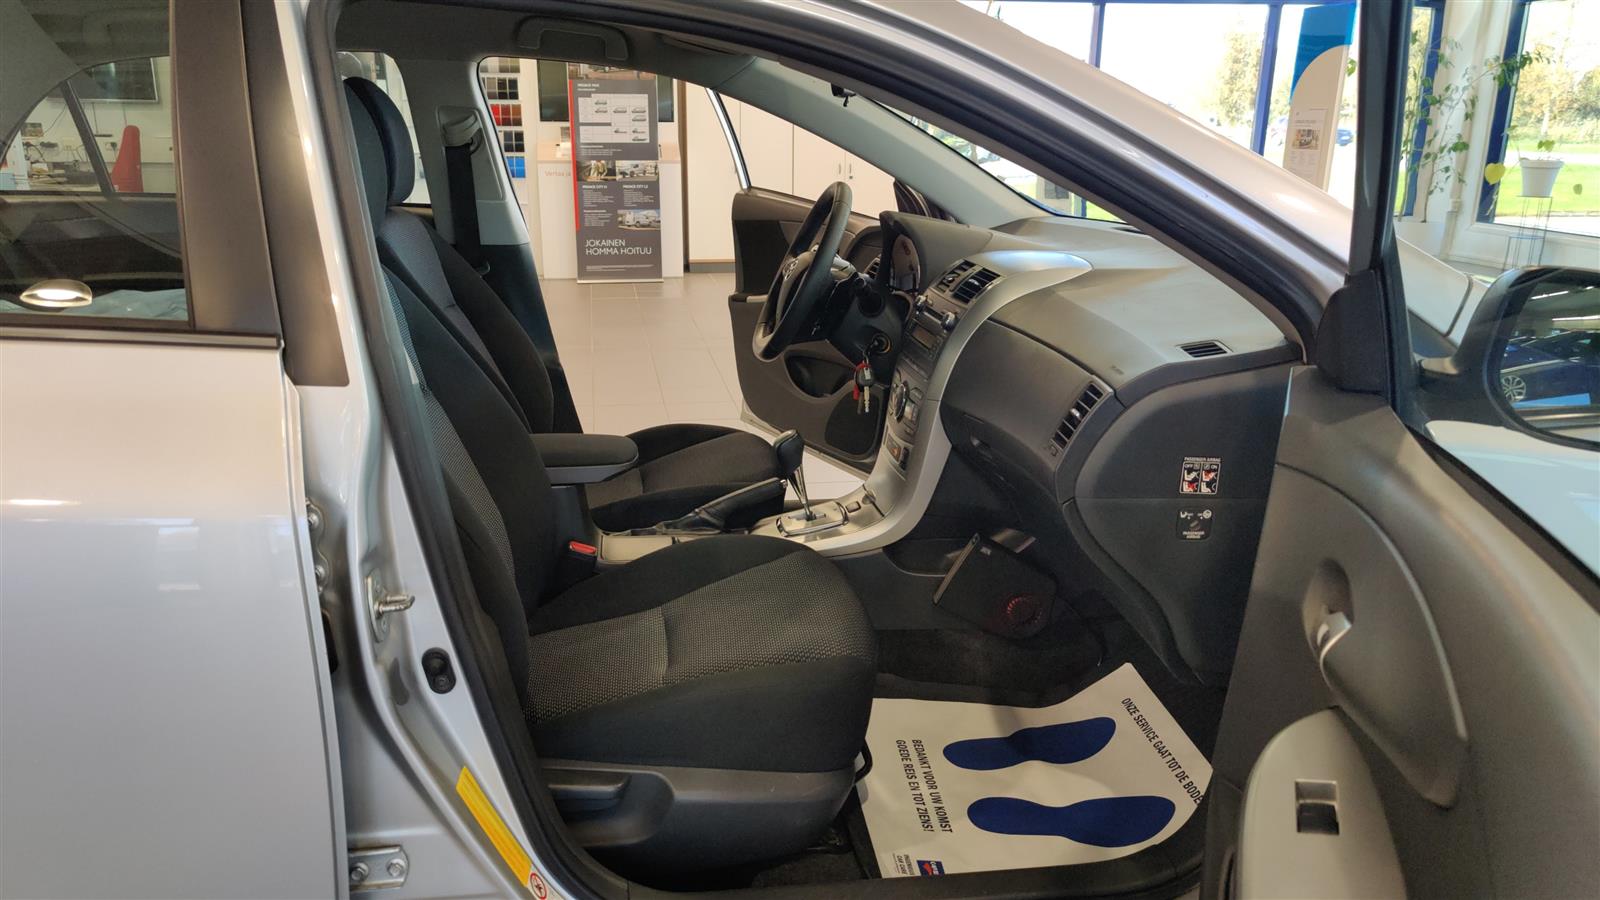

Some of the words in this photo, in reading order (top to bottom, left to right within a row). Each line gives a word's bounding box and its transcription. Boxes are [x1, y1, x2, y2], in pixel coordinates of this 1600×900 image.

[621, 247, 652, 255] HOITUU
[1121, 697, 1138, 716] ONZE
[1134, 714, 1158, 743] SERVICE
[1153, 740, 1172, 759] GAAT
[1166, 757, 1181, 773] TOT
[1175, 770, 1189, 783] DE
[896, 739, 912, 762] GOEDE
[912, 739, 931, 769] BEDANKT
[903, 763, 917, 780] REIS
[923, 770, 938, 790] VOOR
[908, 781, 920, 791] EN
[912, 792, 926, 806] TOT
[929, 791, 943, 805] UW
[916, 807, 935, 832] ZIENS!
[934, 806, 953, 833] KOMST
